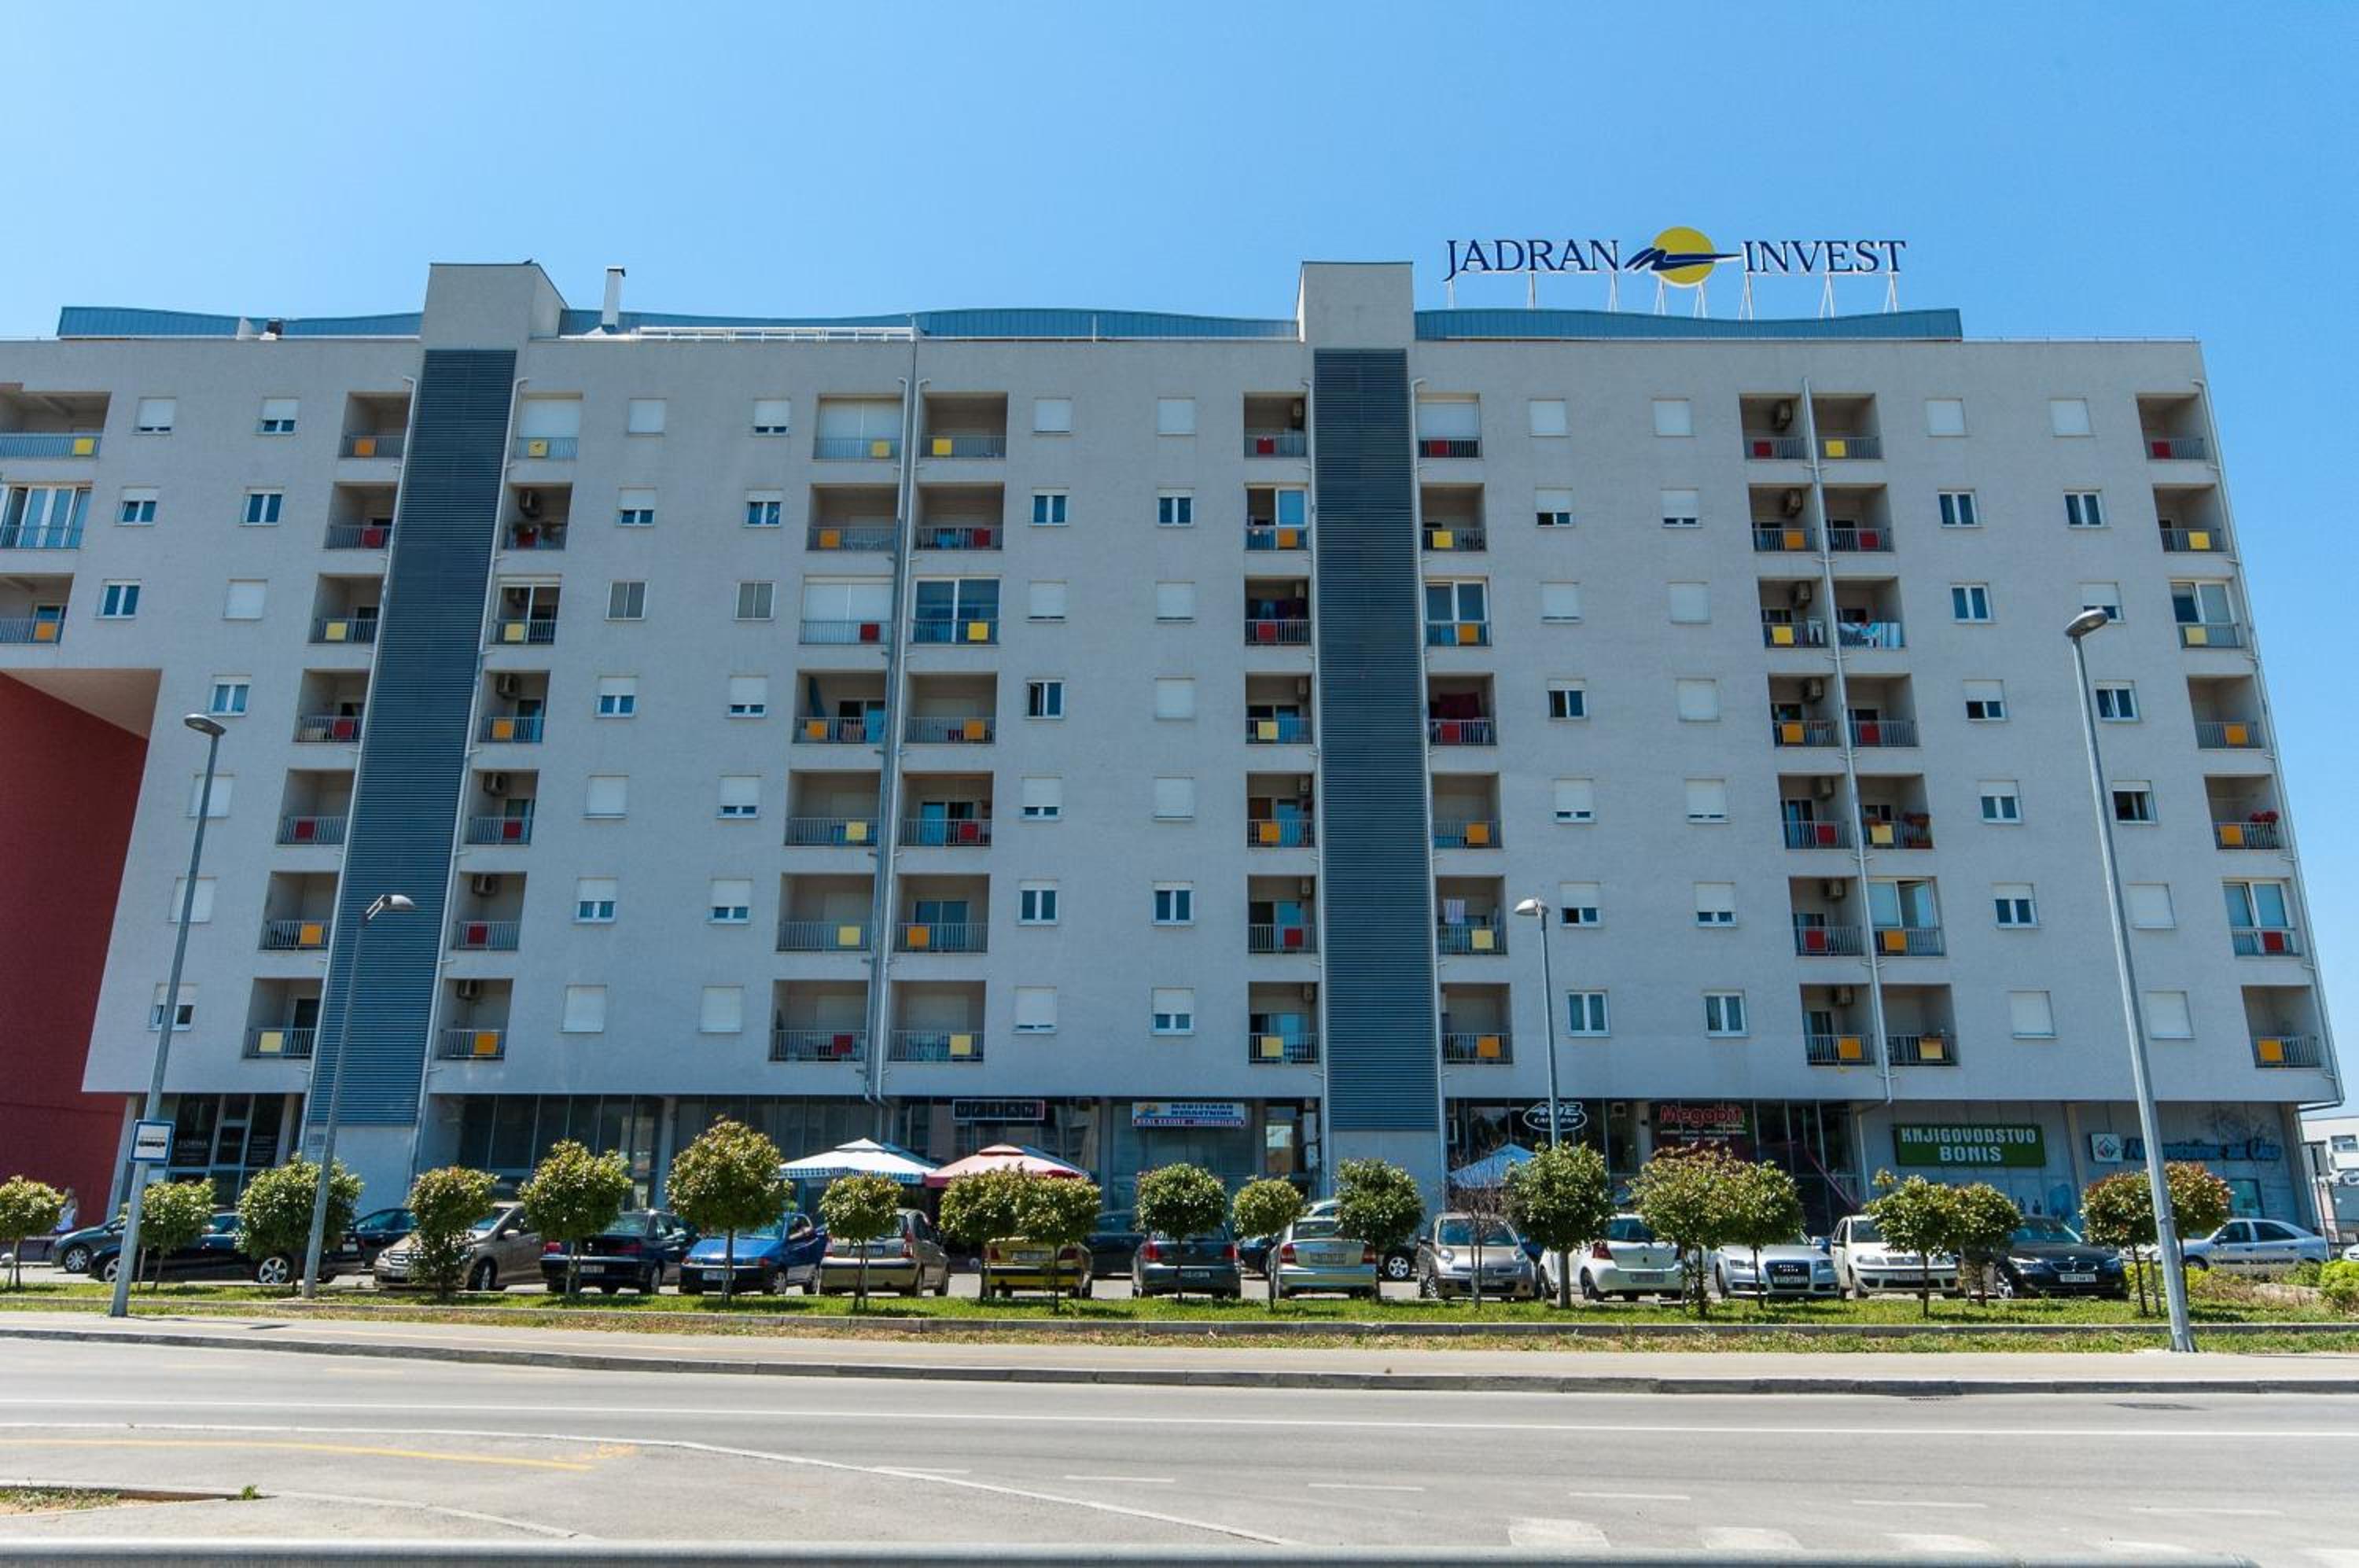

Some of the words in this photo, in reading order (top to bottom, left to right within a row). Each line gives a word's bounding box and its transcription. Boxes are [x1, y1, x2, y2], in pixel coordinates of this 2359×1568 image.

[1443, 239, 1618, 281] JADRAN
[1743, 239, 1906, 272] INVEST
[1661, 1104, 1743, 1128] Megabit
[1901, 1128, 2036, 1143] KNJIGOVODSTVO
[1939, 1146, 2002, 1162] BONIS
